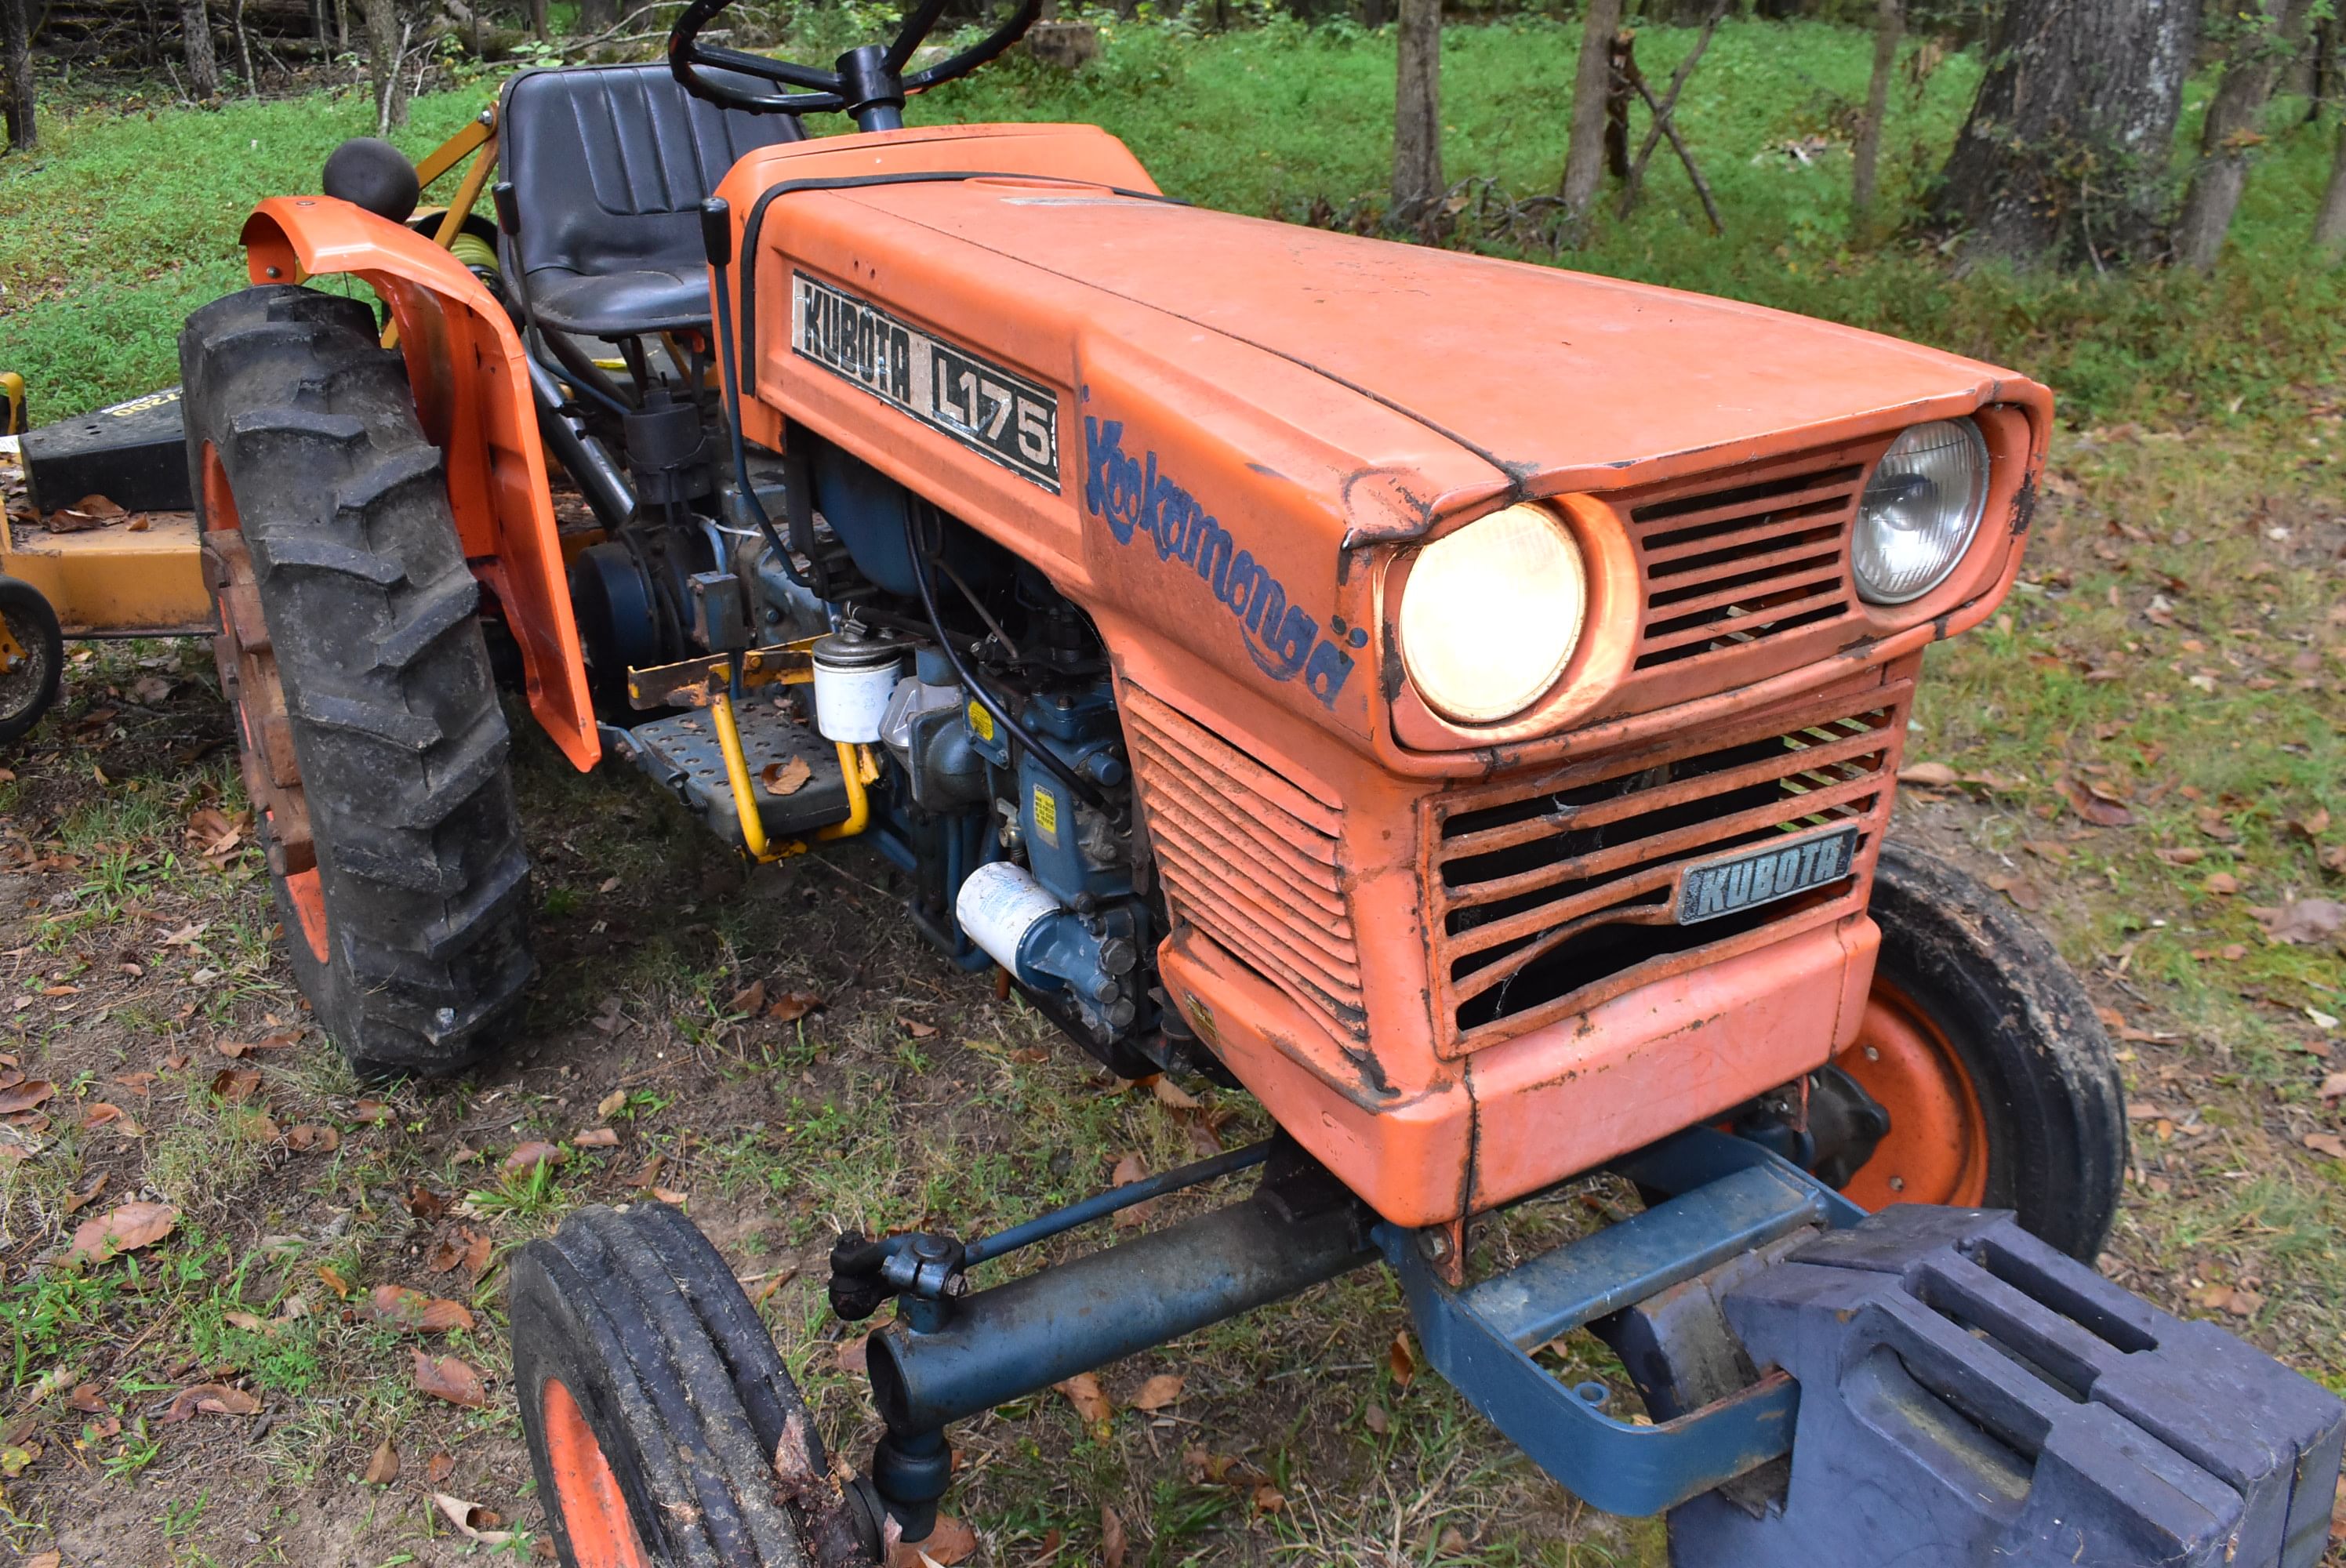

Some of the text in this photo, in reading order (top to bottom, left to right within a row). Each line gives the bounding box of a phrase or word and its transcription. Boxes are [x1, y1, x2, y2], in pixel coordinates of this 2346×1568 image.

[804, 283, 1051, 466] KUBOTA L175
[1697, 835, 1843, 916] KUBOTA
